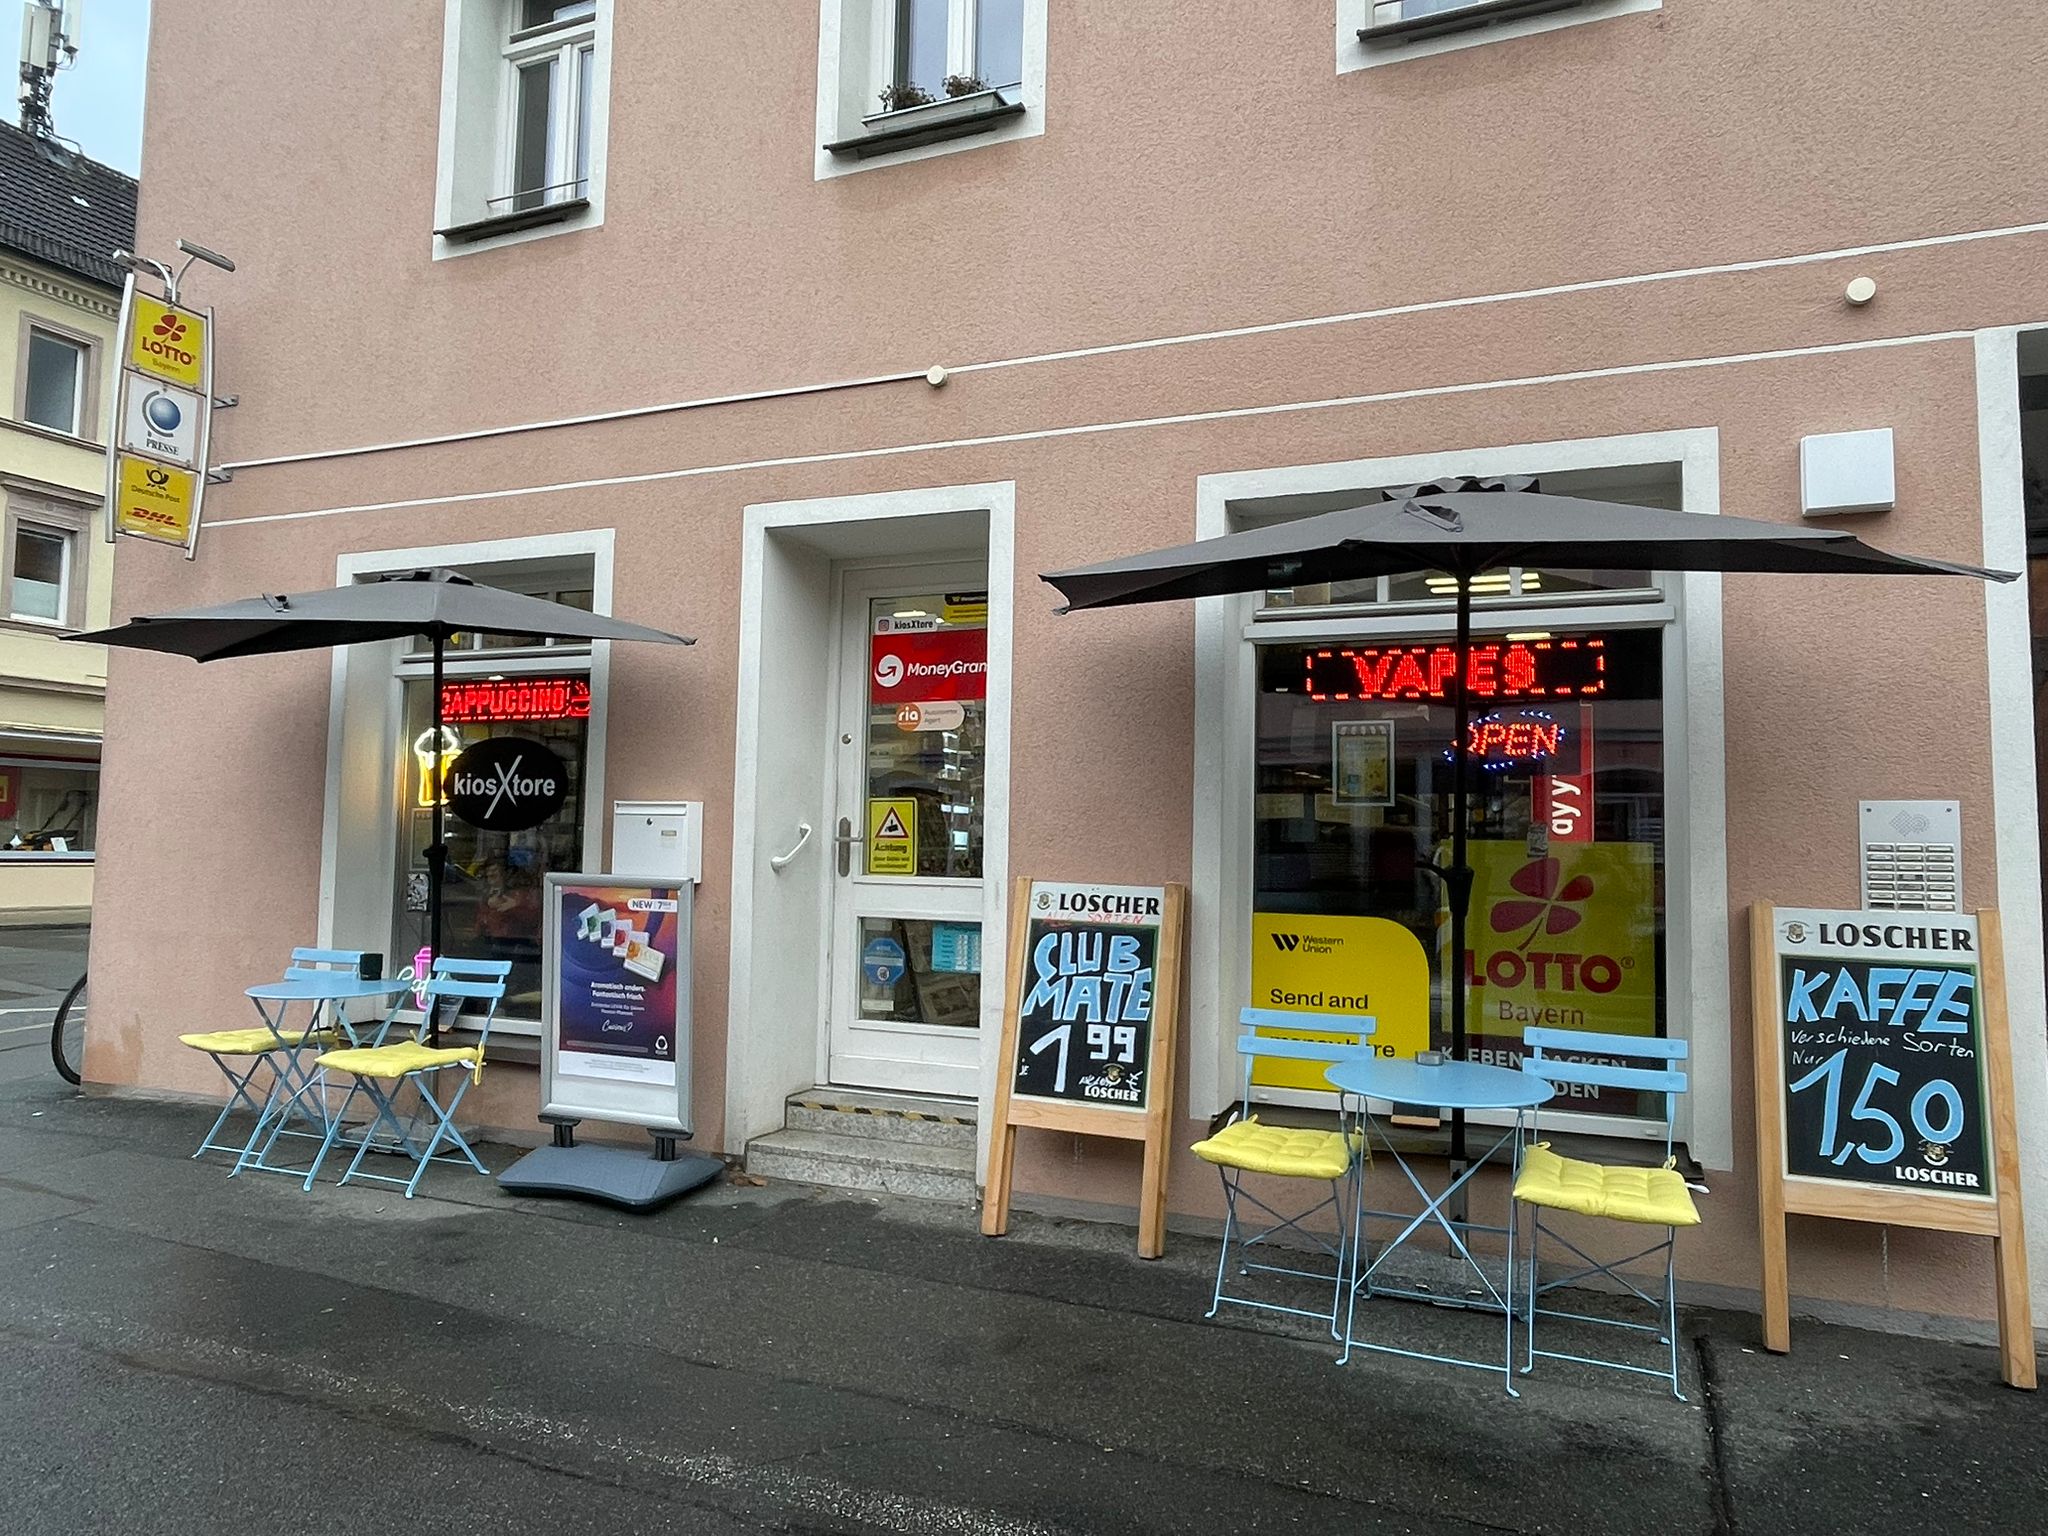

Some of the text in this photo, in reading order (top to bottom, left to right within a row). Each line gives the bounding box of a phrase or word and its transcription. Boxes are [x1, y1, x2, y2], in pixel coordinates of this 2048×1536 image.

[142, 336, 193, 366] LOTTO
[146, 438, 180, 456] PRESSE
[131, 484, 181, 503] Deutsche Post
[130, 507, 178, 526] DHL
[1353, 644, 1535, 692] VAPES
[898, 706, 919, 721] ria
[454, 755, 556, 820] kiosXtore
[874, 843, 908, 854] Achtung
[632, 900, 653, 909] NEW
[1059, 893, 1160, 915] LOSCHER
[1302, 935, 1344, 945] Western
[1819, 922, 1975, 951] LOSCHER
[1034, 932, 1141, 980] CLUB
[1302, 944, 1332, 954] Union
[1021, 967, 1152, 1023] MATE
[1270, 988, 1368, 1010] Send and
[1787, 967, 1976, 1034] KAFFE
[1500, 1001, 1584, 1027] Bayern
[1441, 1046, 1524, 1067] KEBEN
[1902, 1033, 1975, 1059] Sorten
[1793, 1049, 1824, 1066] Nur
[1084, 1086, 1139, 1101] LOSCHER
[1788, 1048, 1964, 1166] 1,50
[1895, 1166, 1980, 1187] LOSCHER
